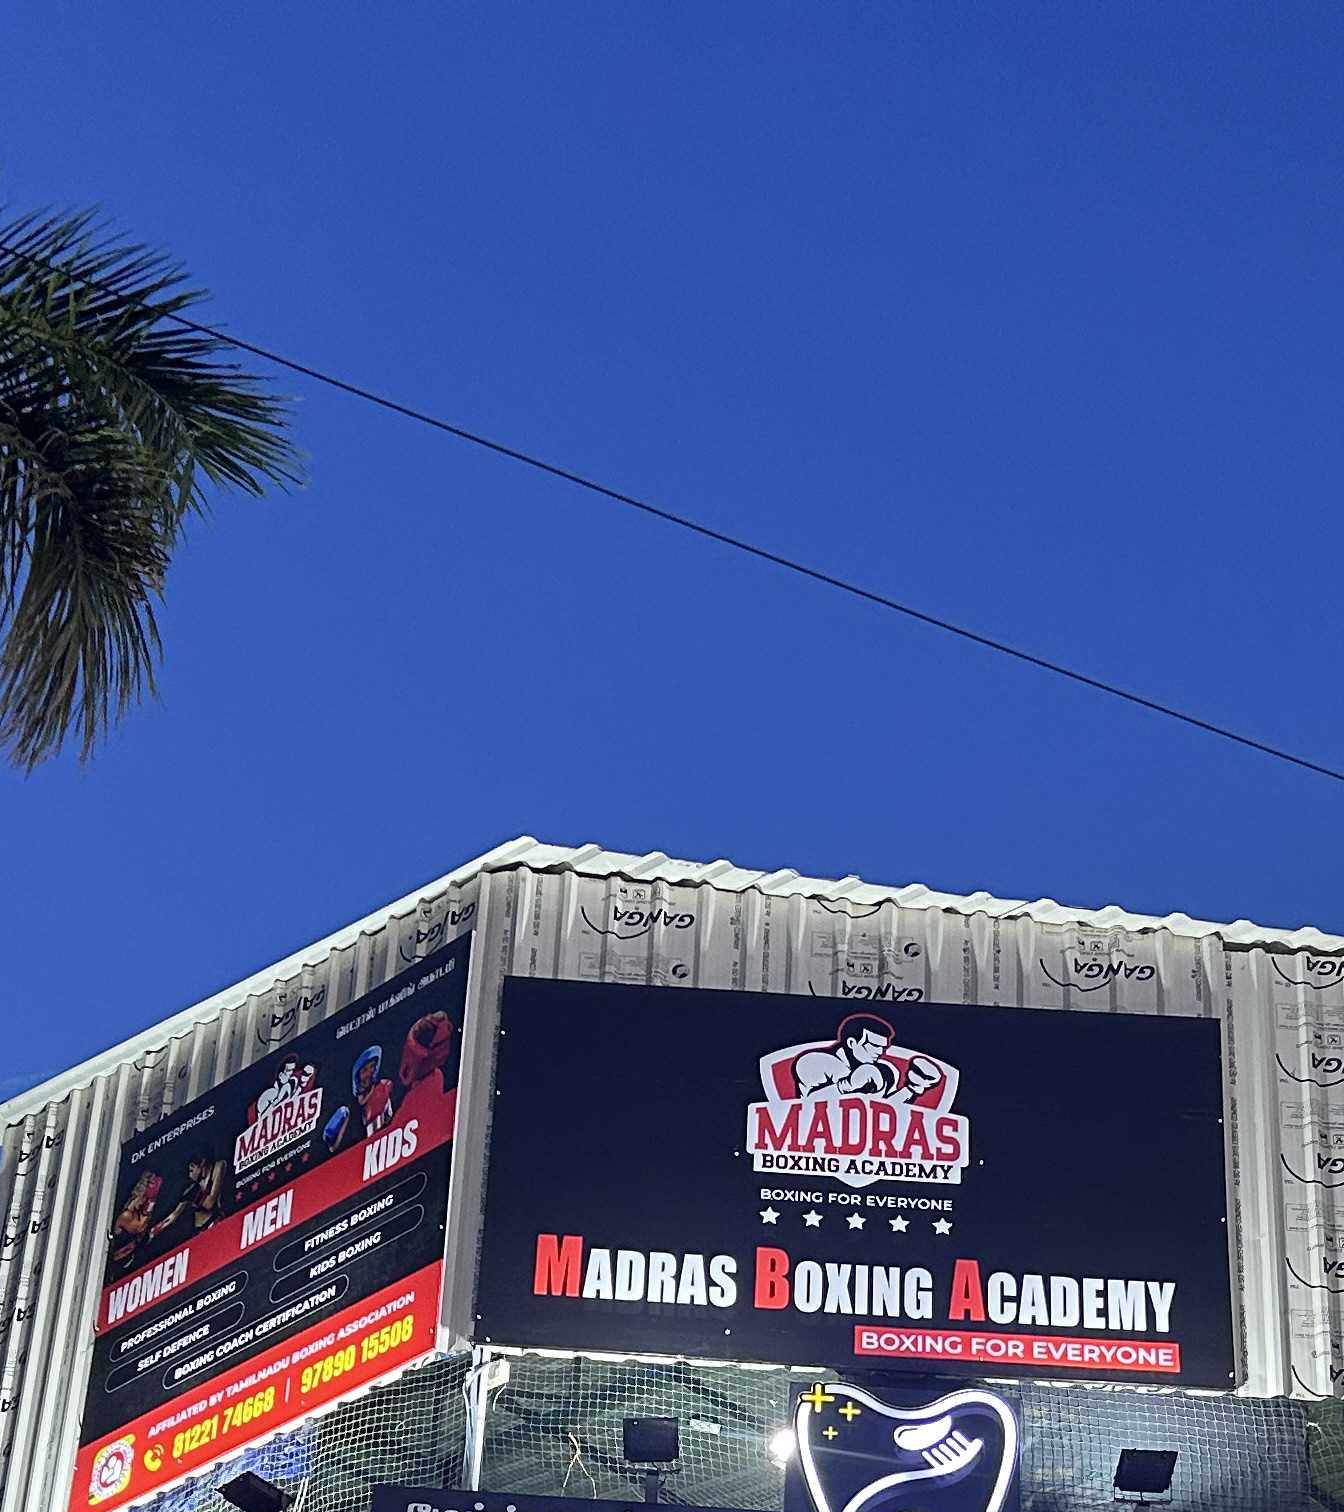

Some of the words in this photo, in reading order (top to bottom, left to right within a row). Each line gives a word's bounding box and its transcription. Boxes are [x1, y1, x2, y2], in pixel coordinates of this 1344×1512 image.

[614, 906, 694, 928] GANGA
[1074, 957, 1154, 982] GANGA
[147, 1105, 215, 1153] ENTERPRISES
[238, 1092, 319, 1162] MADRAS
[754, 1097, 961, 1162] MADRAS
[761, 1153, 840, 1174] BOXING
[844, 1159, 953, 1180] ACADEMY
[108, 1248, 190, 1324] WOMEN
[240, 1188, 294, 1250] MEN
[362, 1119, 419, 1183] KIDS
[304, 1218, 350, 1252] FITNESS
[350, 1194, 395, 1231] BOXING
[760, 1188, 823, 1203] BOXING
[828, 1193, 861, 1206] FOR
[866, 1196, 953, 1211] EVERYONE
[309, 1255, 337, 1279] KIDS
[336, 1231, 382, 1265] BOXING
[533, 1233, 738, 1308] MADRAS
[754, 1246, 934, 1320] BOXING
[947, 1258, 1177, 1334] ACADEMY
[120, 1304, 196, 1353] PROFESSIONAL
[195, 1280, 237, 1318] BOXING
[174, 1350, 215, 1380] BOXING
[215, 1328, 254, 1361] COACH
[255, 1285, 337, 1341] CERTIFICATION
[137, 1346, 163, 1372] SELF
[162, 1324, 211, 1355] DEFENCE
[148, 1402, 208, 1439] AFFILIATED
[208, 1391, 224, 1408] BY
[224, 1358, 290, 1399] TAMILNADU
[291, 1332, 336, 1365] BOXING
[336, 1291, 416, 1342] ASSOCIATION
[861, 1332, 963, 1356] BOXING
[971, 1337, 1025, 1359] FOR
[1032, 1341, 1174, 1368] EVERYONE
[172, 1412, 218, 1459] 81221
[222, 1386, 276, 1436] 74668
[300, 1344, 356, 1394] 97890
[360, 1315, 414, 1364] 15508
